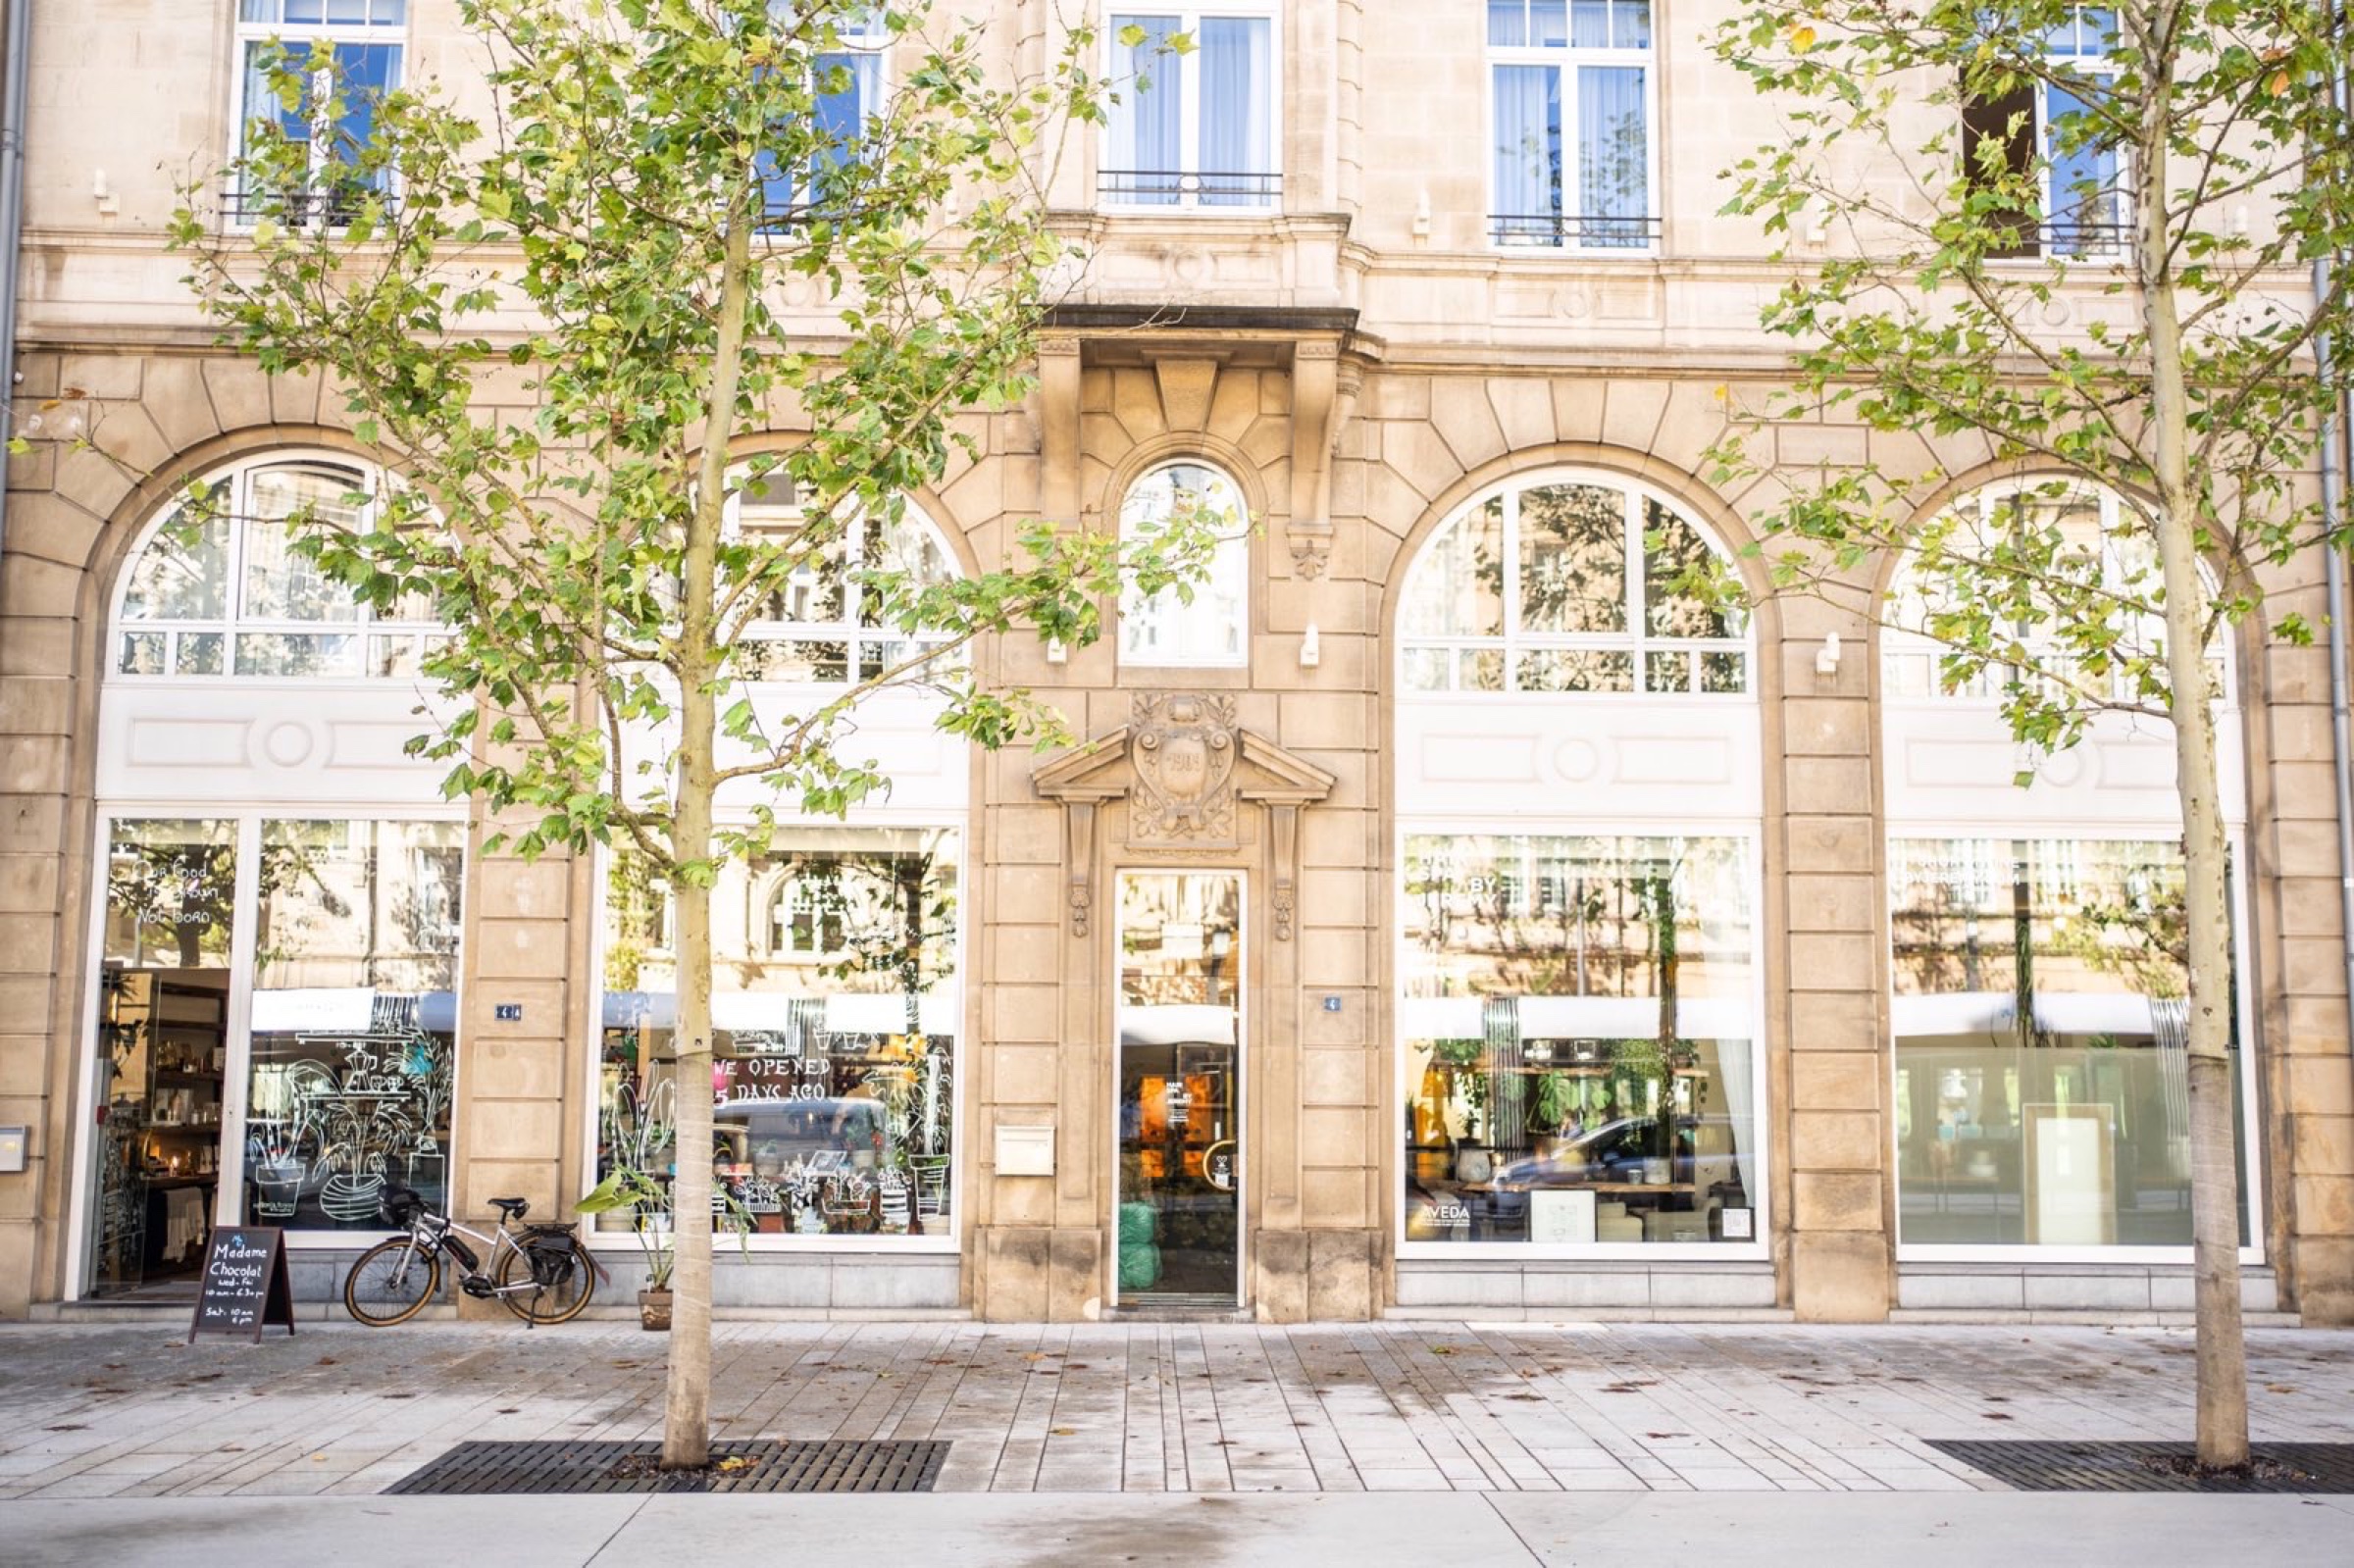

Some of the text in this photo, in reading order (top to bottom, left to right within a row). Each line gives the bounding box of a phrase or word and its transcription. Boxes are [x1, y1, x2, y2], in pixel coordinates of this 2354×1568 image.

[1470, 876, 1497, 893] BY
[748, 1059, 831, 1077] OPENED
[736, 1082, 782, 1101] DAYS
[789, 1082, 826, 1101] AGO
[1421, 1205, 1471, 1219] AVEDA
[214, 1243, 268, 1259] Madame
[209, 1261, 262, 1278] Chocolat
